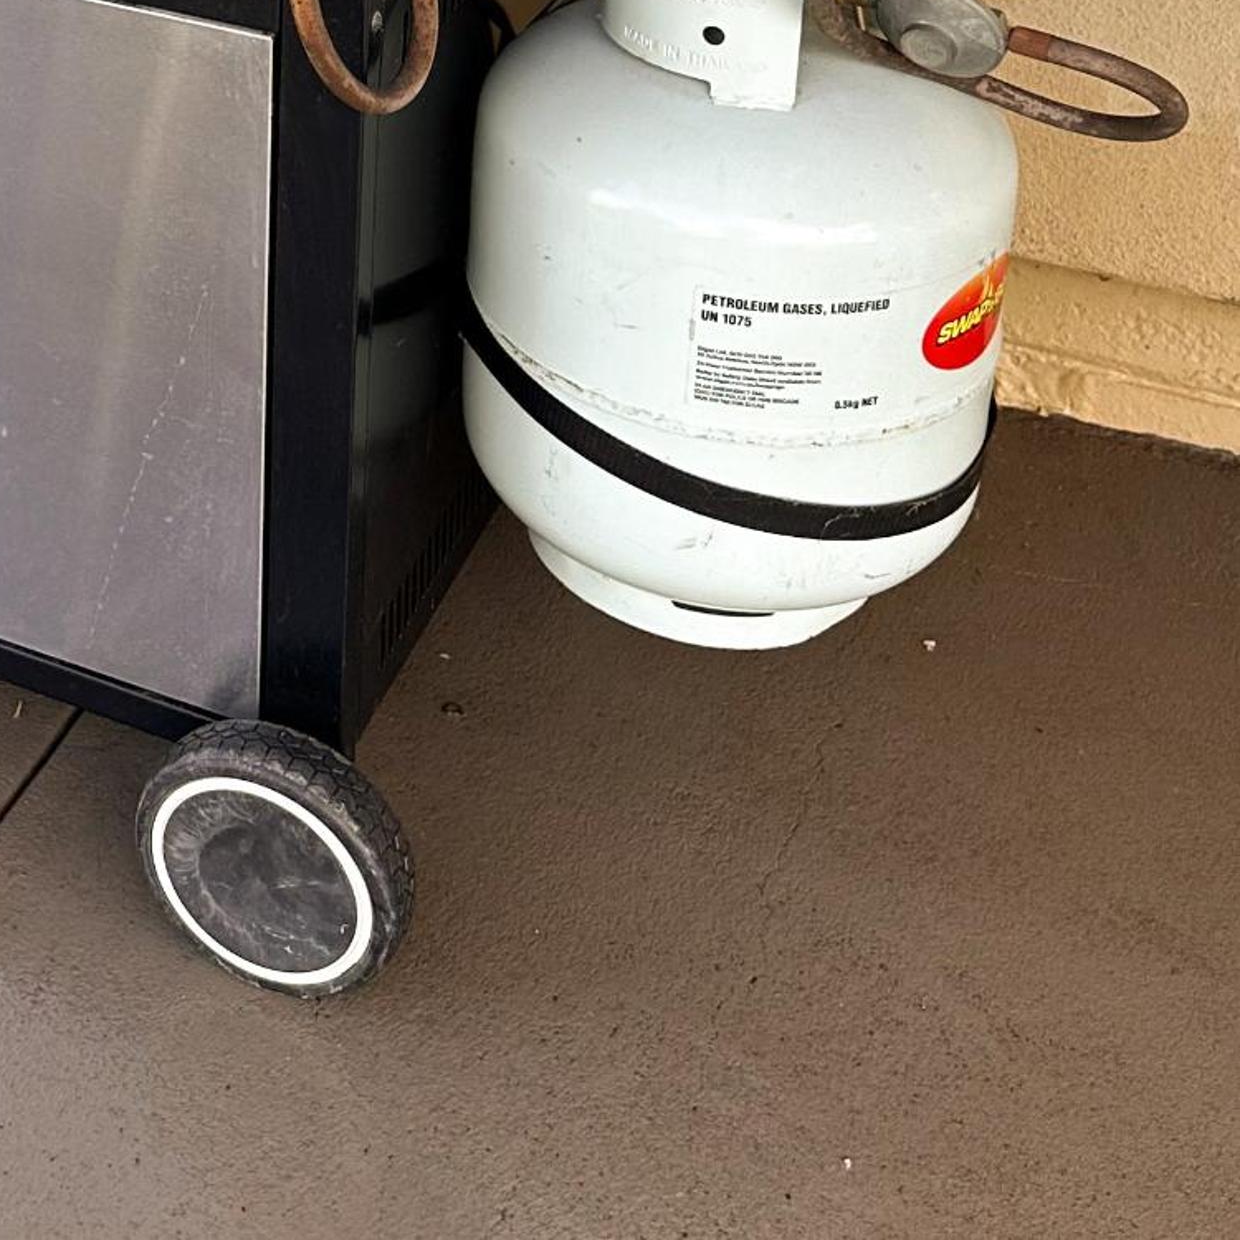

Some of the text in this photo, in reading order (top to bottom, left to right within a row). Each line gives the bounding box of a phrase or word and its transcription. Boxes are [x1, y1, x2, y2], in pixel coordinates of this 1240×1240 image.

[702, 293, 890, 316] PETROLEUM GASES, LIQUEFIED
[701, 309, 753, 328] UN 1075
